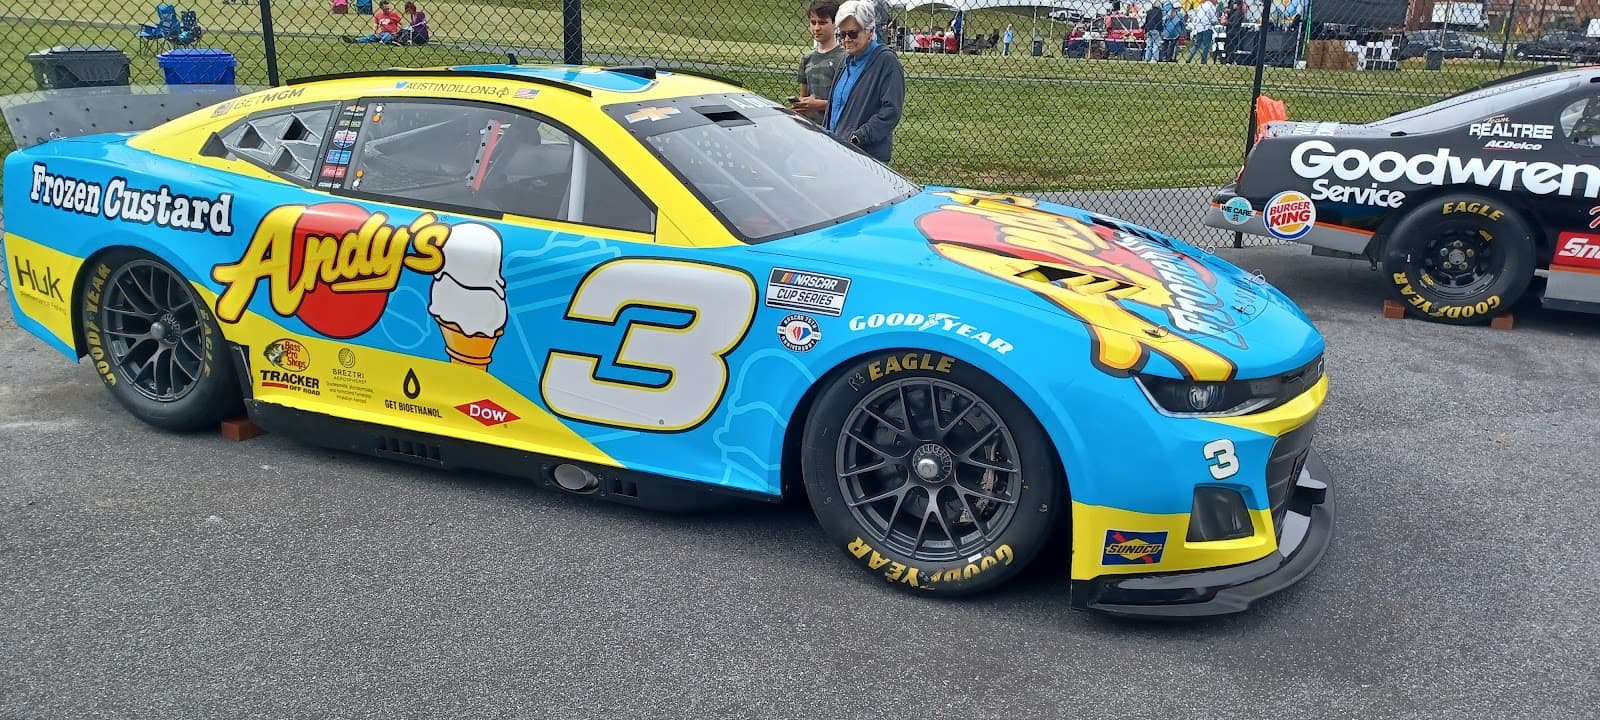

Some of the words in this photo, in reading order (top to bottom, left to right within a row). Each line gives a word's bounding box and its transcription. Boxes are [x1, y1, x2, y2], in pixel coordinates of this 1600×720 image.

[233, 83, 305, 110] BETMGM
[1469, 123, 1554, 139] REALTREE
[1484, 140, 1542, 150] ACDelco
[31, 163, 101, 215] Frozen
[103, 178, 232, 233] Custard
[1311, 179, 1406, 208] Service
[1221, 205, 1232, 213] WE
[1233, 207, 1253, 217] CARE
[1269, 201, 1311, 216] BURGER
[1442, 201, 1504, 221] EAGLE
[1269, 210, 1311, 228] KING
[211, 204, 450, 323] Andy's
[794, 273, 838, 290] NASCAR
[777, 288, 798, 301] CUP
[798, 290, 833, 305] SERIES
[285, 341, 301, 352] Bass
[540, 257, 758, 433] 3
[286, 350, 298, 359] Pro
[287, 358, 306, 370] Shops
[868, 352, 955, 382] EAGLE
[260, 370, 320, 389] TRACKER
[332, 368, 365, 379] BREZTRI
[303, 388, 320, 396] ROAD
[384, 399, 397, 409] GET
[398, 401, 442, 418] BIOETHANOL
[1202, 438, 1241, 480] 3
[1108, 545, 1161, 554] SUNOCO
